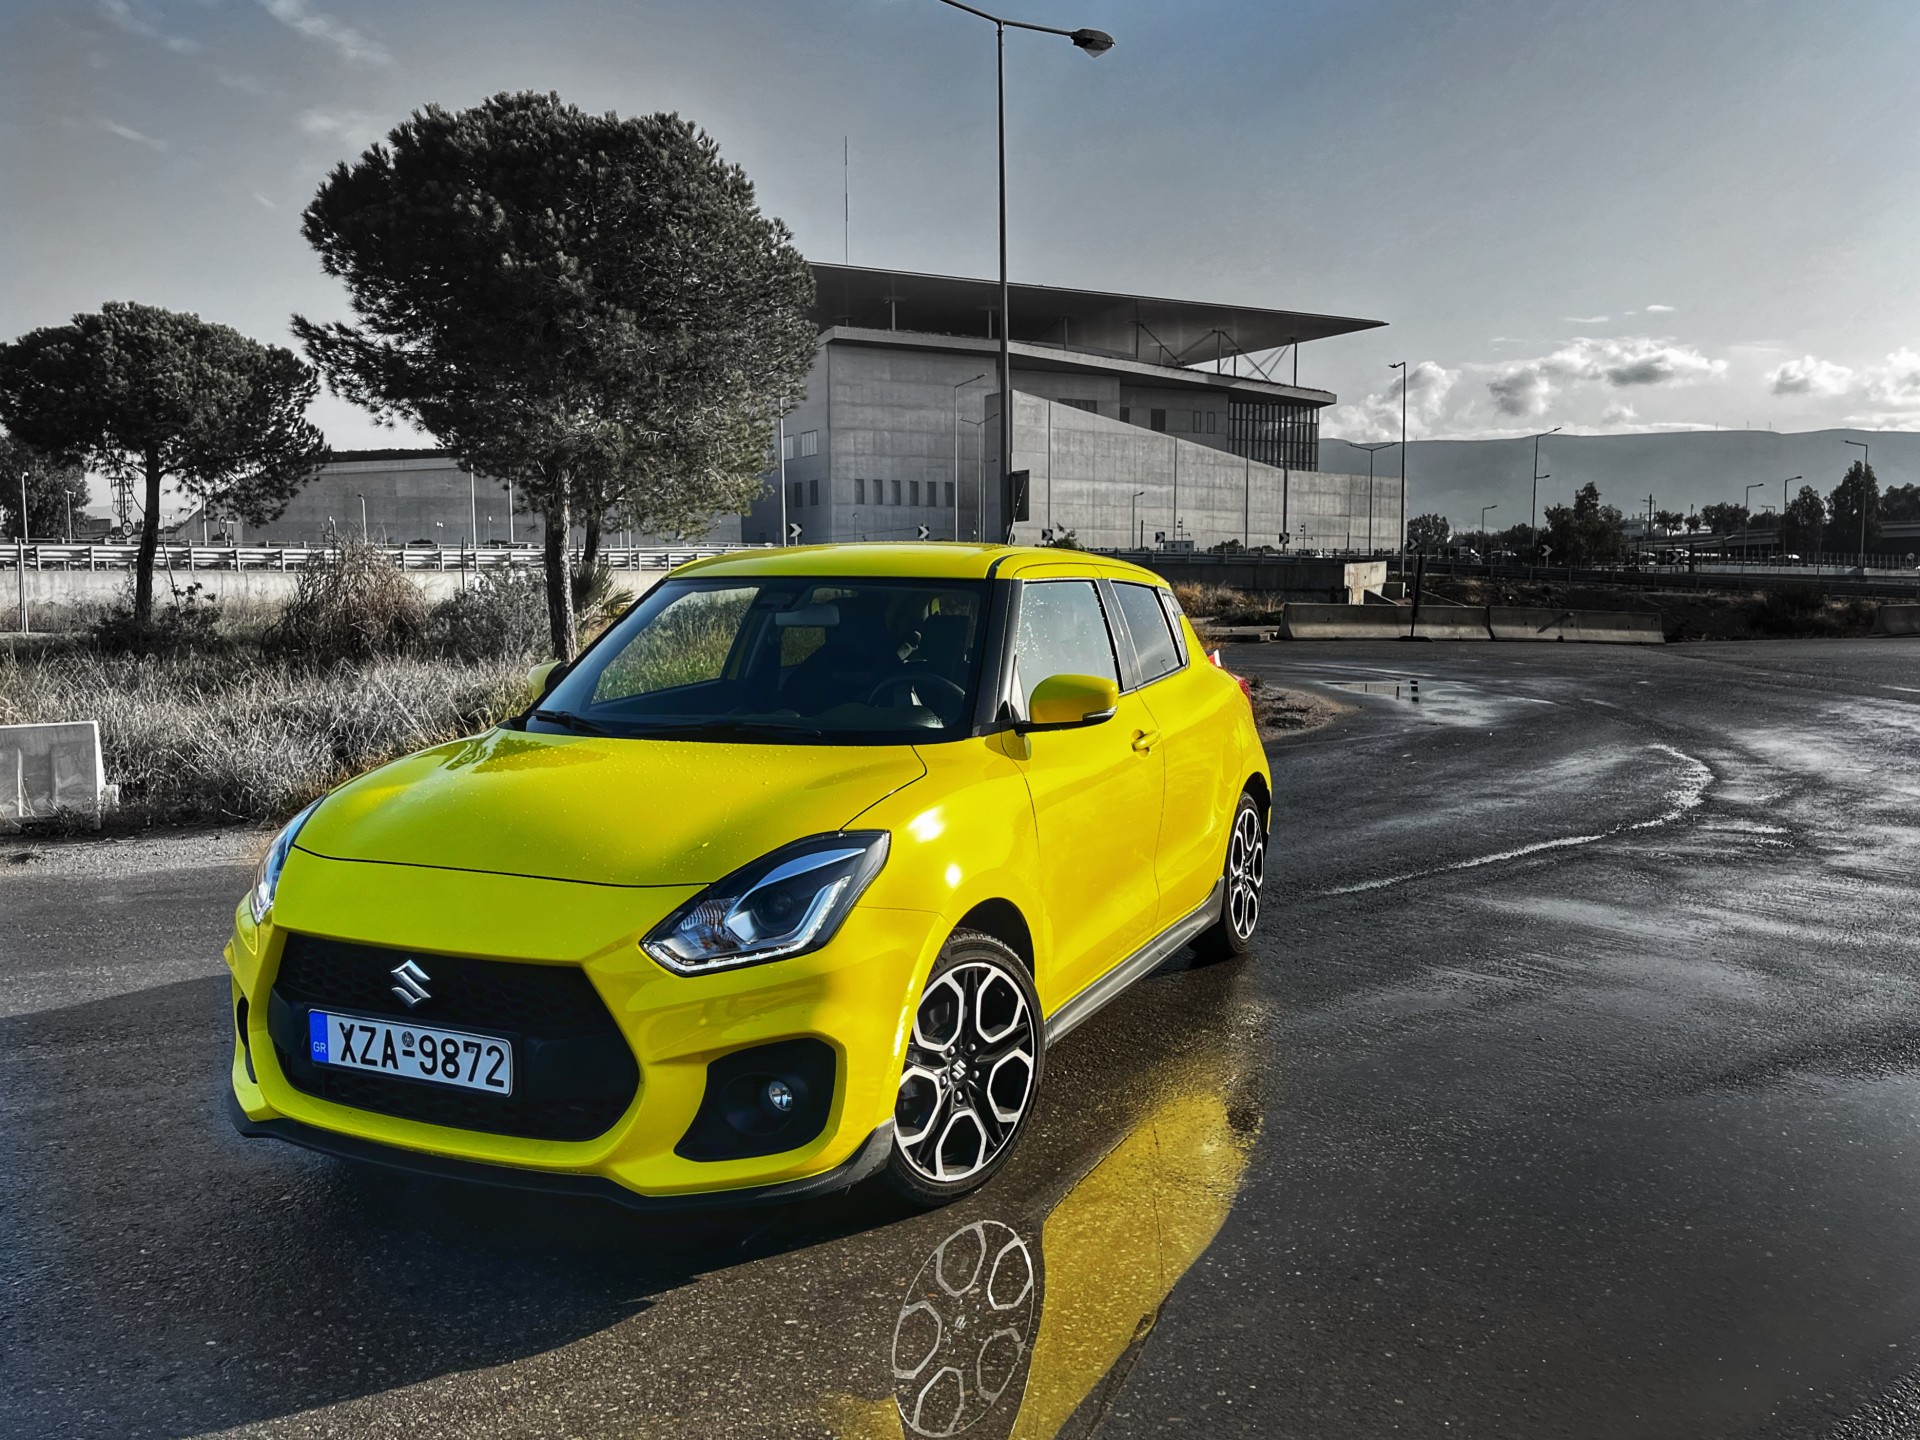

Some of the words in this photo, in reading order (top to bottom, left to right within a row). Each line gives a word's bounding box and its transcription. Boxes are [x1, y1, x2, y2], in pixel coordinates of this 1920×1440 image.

[124, 525, 132, 533] 70
[313, 1041, 326, 1054] GR
[338, 1022, 505, 1088] XZA-9872
